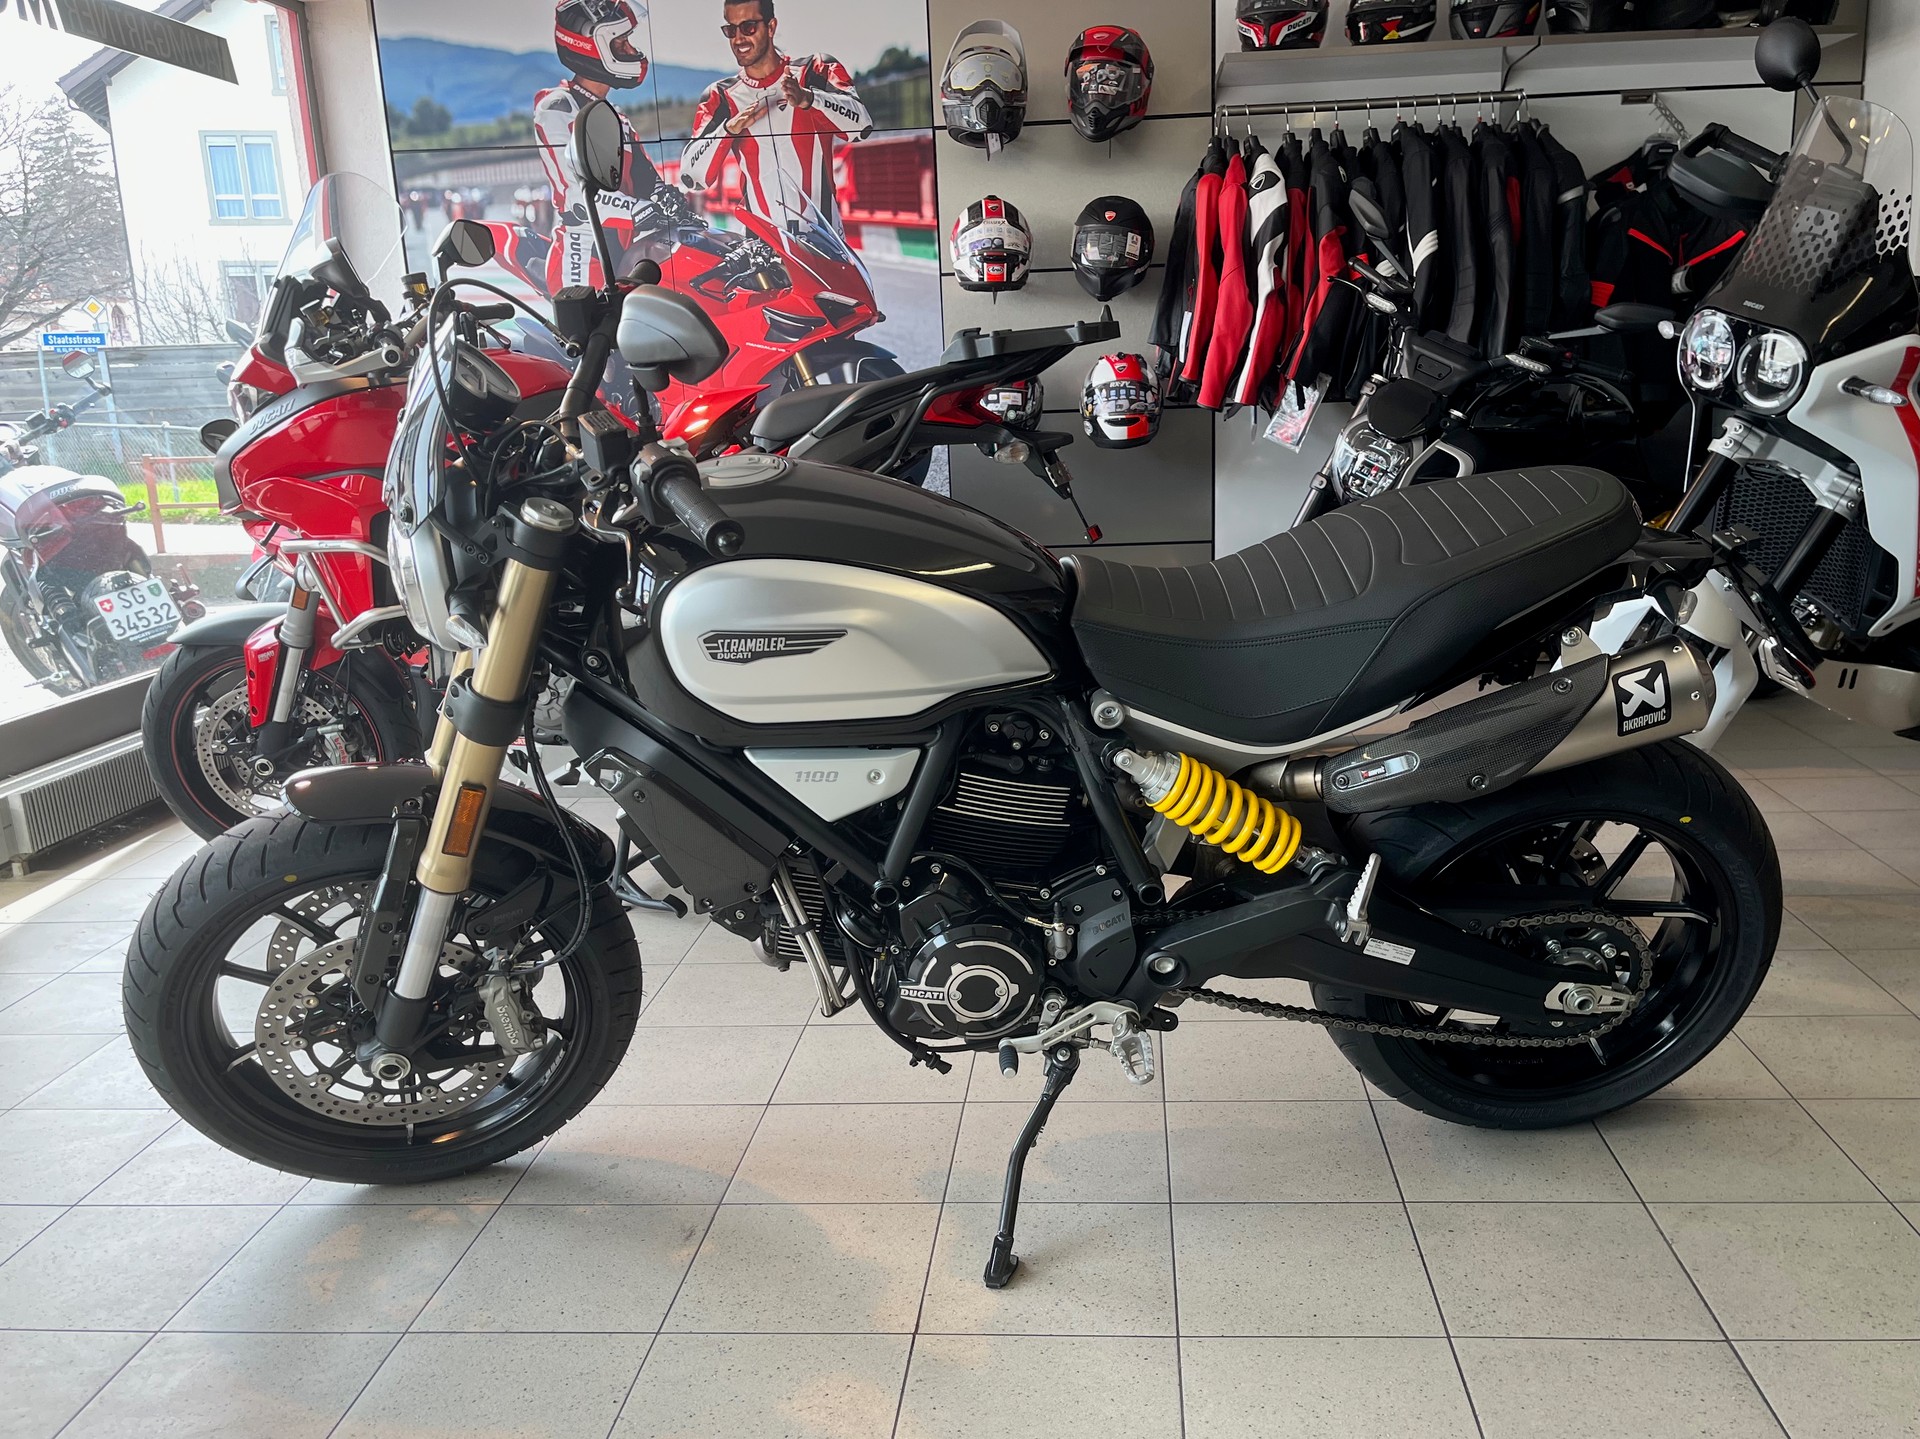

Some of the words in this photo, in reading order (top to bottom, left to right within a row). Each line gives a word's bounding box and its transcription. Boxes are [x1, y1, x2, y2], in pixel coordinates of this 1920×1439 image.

[1287, 16, 1312, 32] DUCATI
[573, 84, 600, 101] DUCA
[824, 99, 860, 124] DUCATI
[634, 206, 654, 223] DUCATI
[570, 232, 582, 283] DUCATI
[47, 335, 101, 345] Staatsstrasse
[117, 587, 147, 609] SG
[111, 602, 178, 637] 34532
[717, 636, 786, 653] SCRAMBLER
[717, 652, 752, 660] DUCATI
[794, 770, 839, 783] 1100
[1092, 912, 1126, 936] DUCATI
[900, 988, 945, 1000] DUCATI
[496, 1004, 519, 1045] brembo
